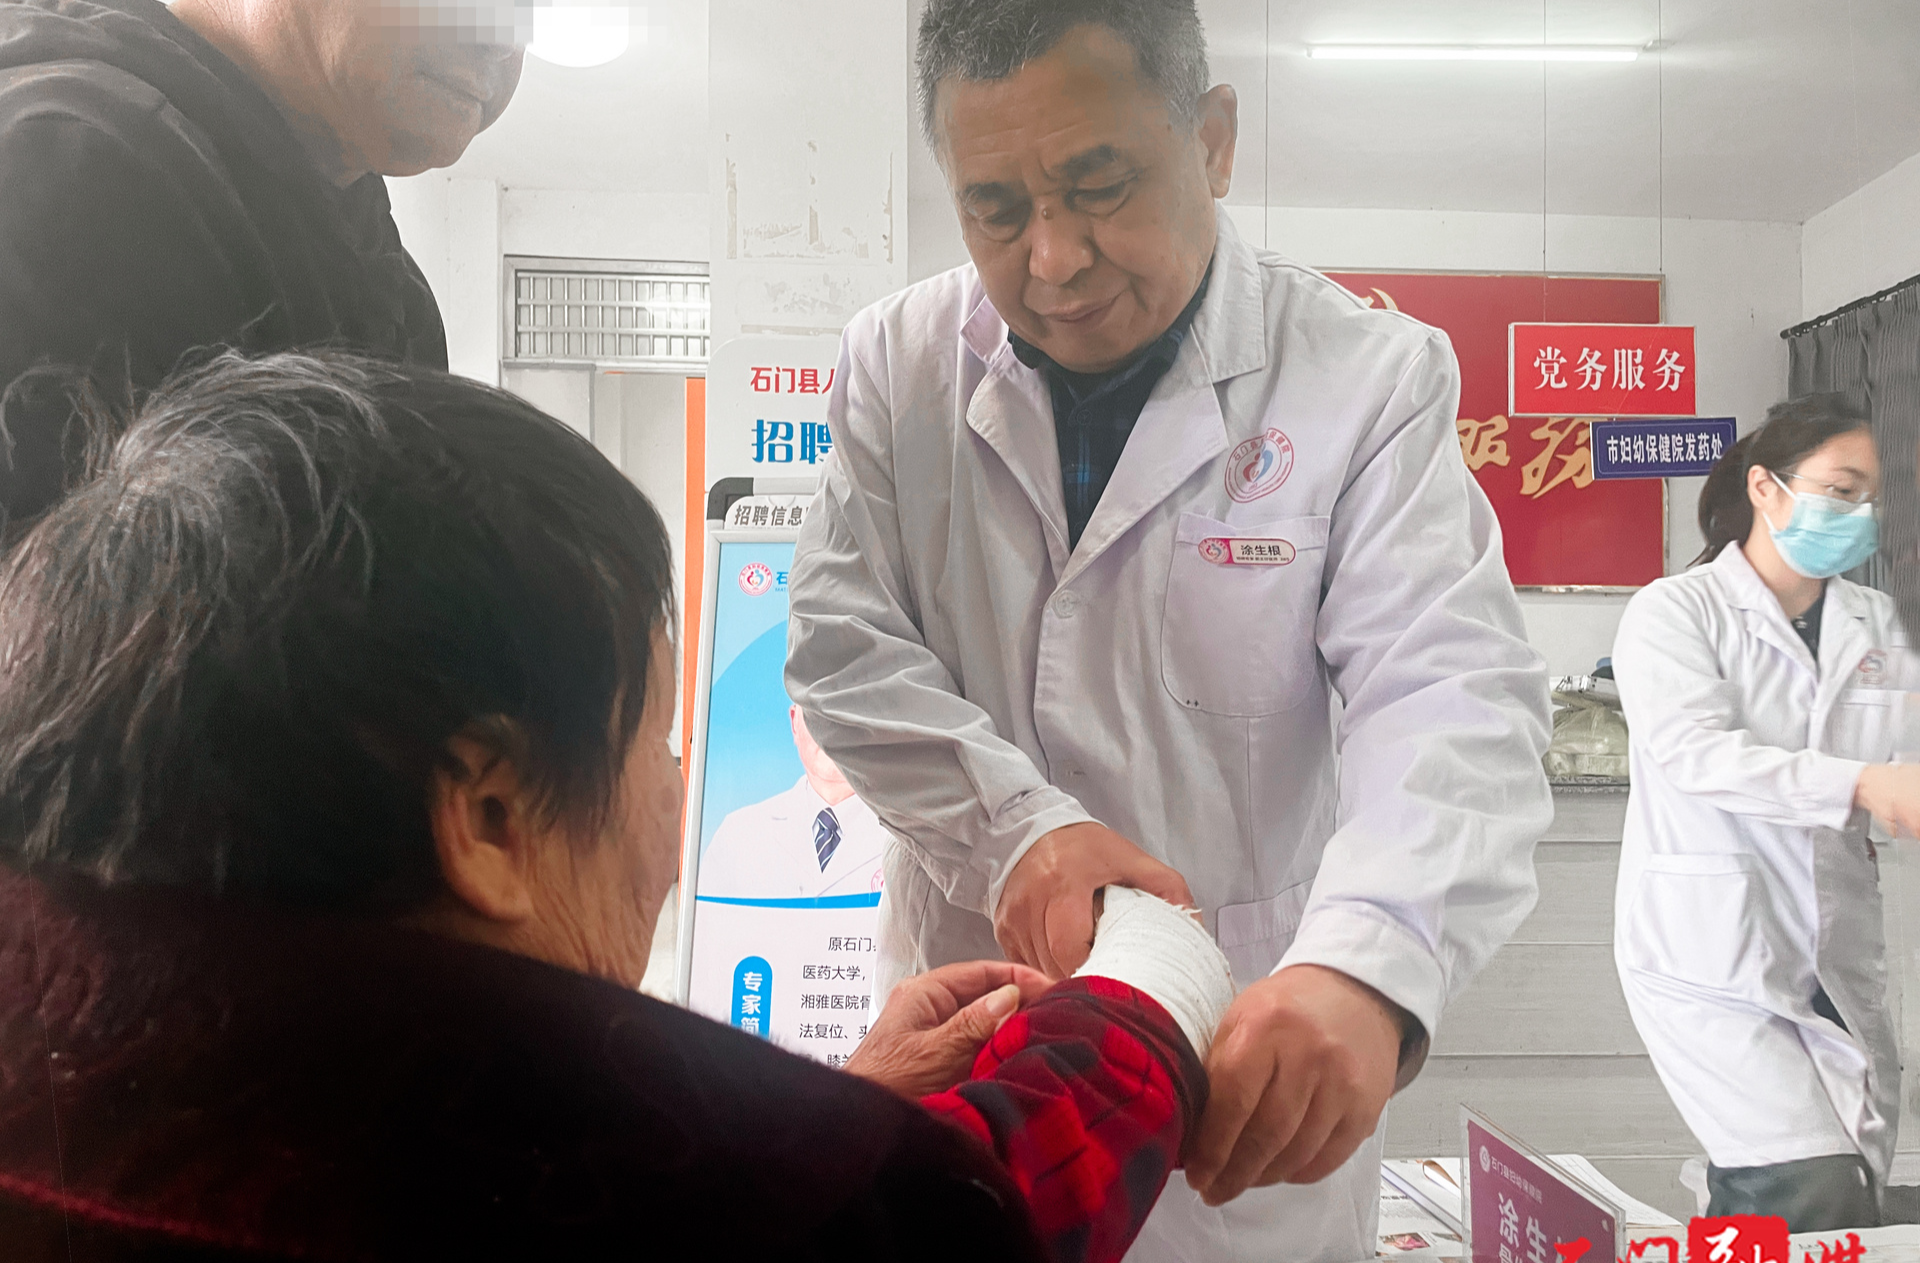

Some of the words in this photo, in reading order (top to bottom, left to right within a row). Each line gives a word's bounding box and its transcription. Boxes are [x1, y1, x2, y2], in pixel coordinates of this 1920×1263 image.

[1533, 346, 1686, 392] 党务服务
[751, 419, 833, 465] 招聘
[1606, 432, 1723, 464] 市妇幼保健院发药处
[734, 504, 809, 526] 招聘信息
[1240, 544, 1282, 557] 涂生根
[827, 936, 877, 952] 原石门
